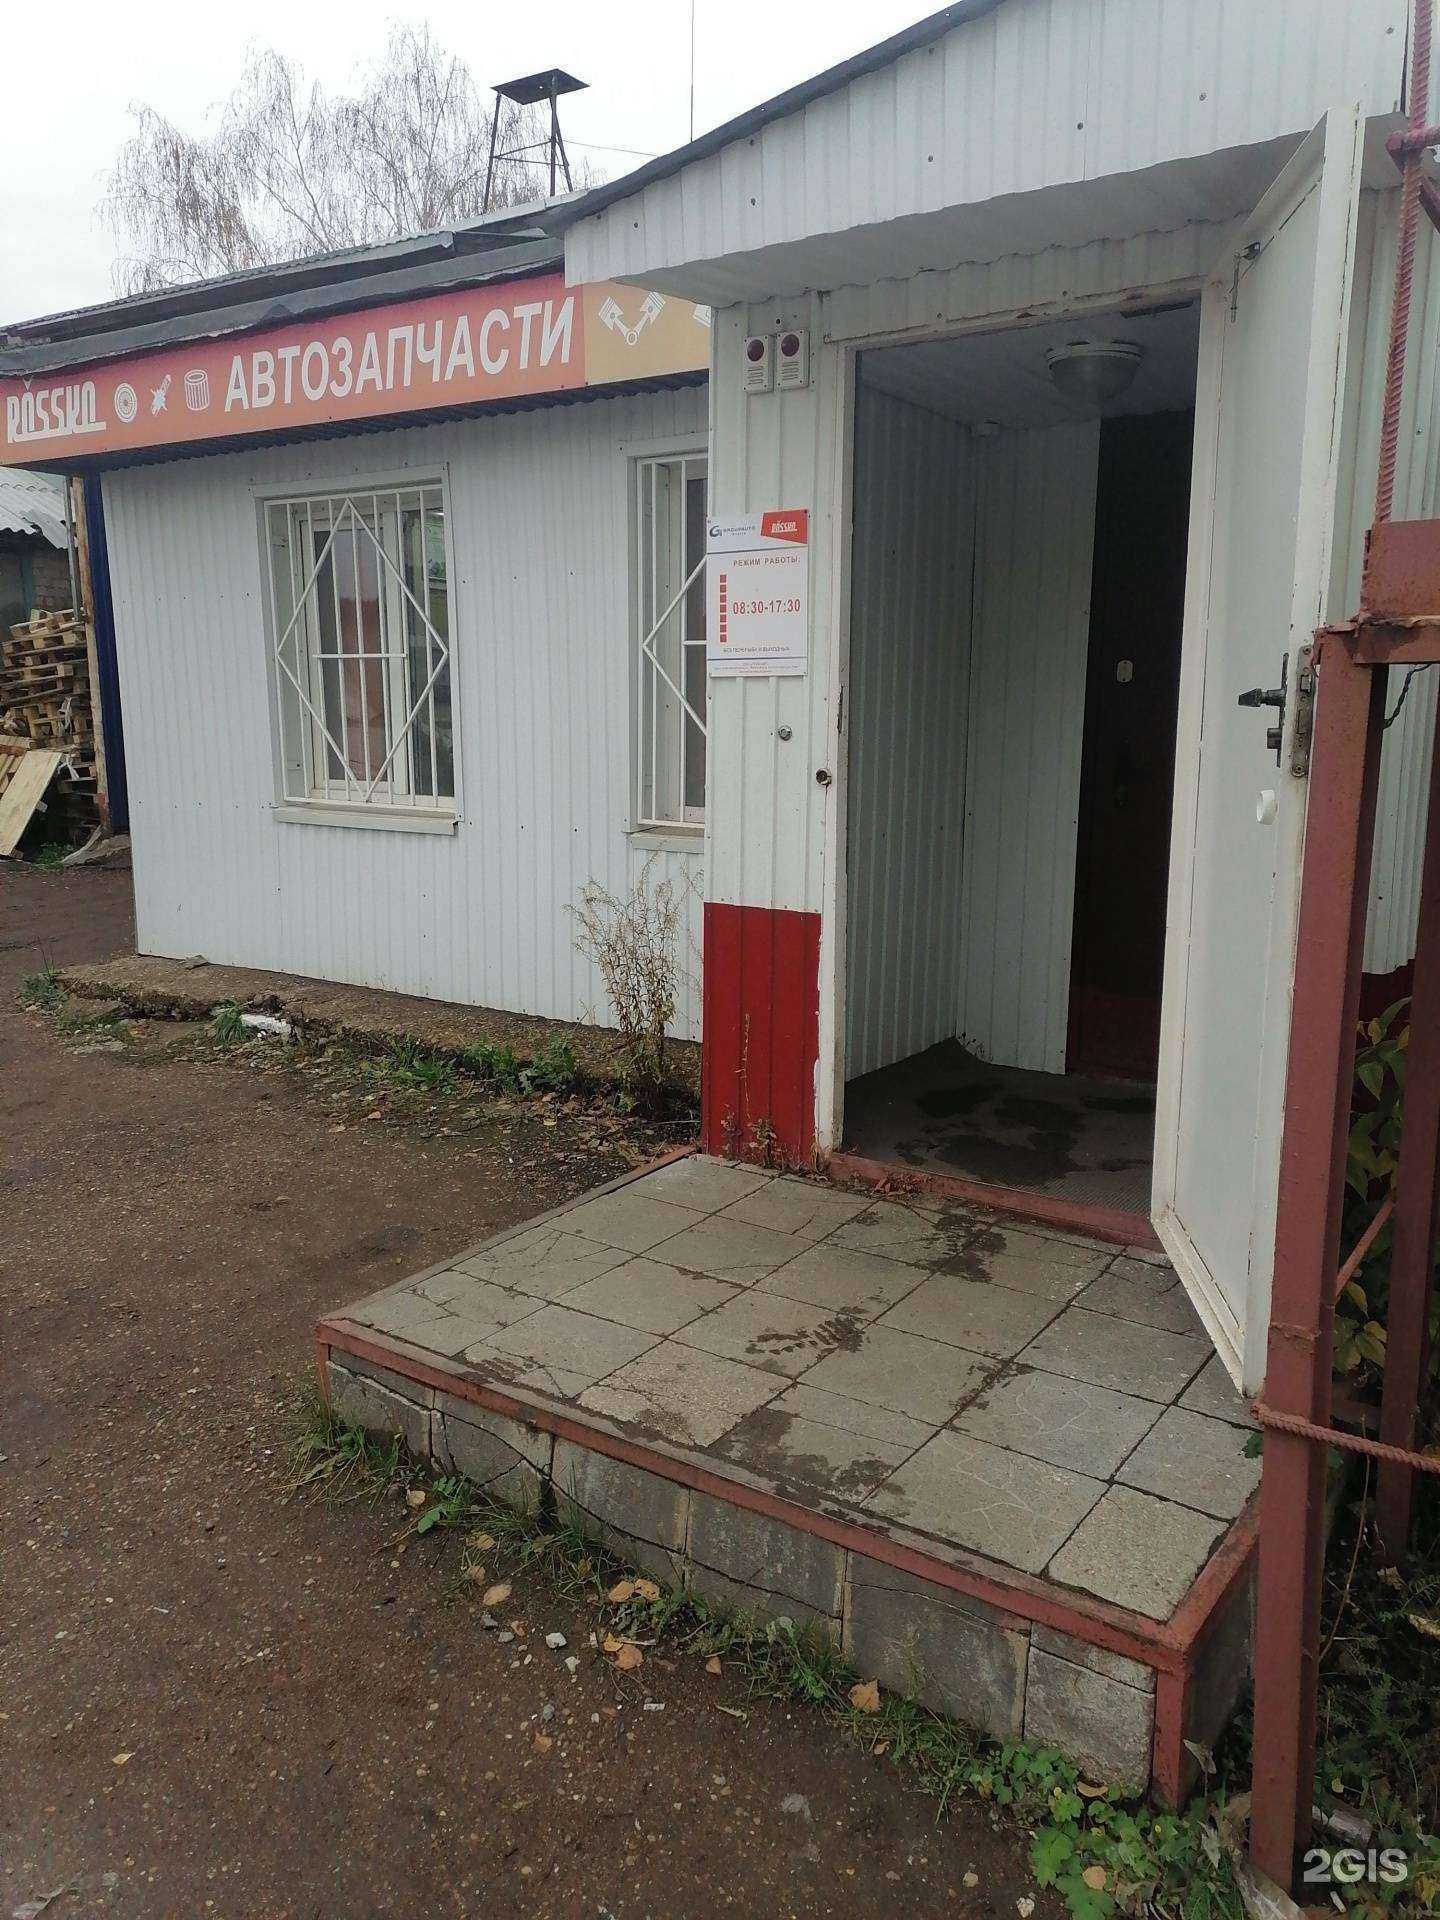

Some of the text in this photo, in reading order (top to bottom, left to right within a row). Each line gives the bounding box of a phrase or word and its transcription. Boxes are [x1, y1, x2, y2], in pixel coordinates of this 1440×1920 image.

[224, 296, 574, 413] АВТОЗАПЧАСТИ
[733, 558, 760, 567] РЕЖИМ
[733, 599, 801, 615] 08:30-17:30
